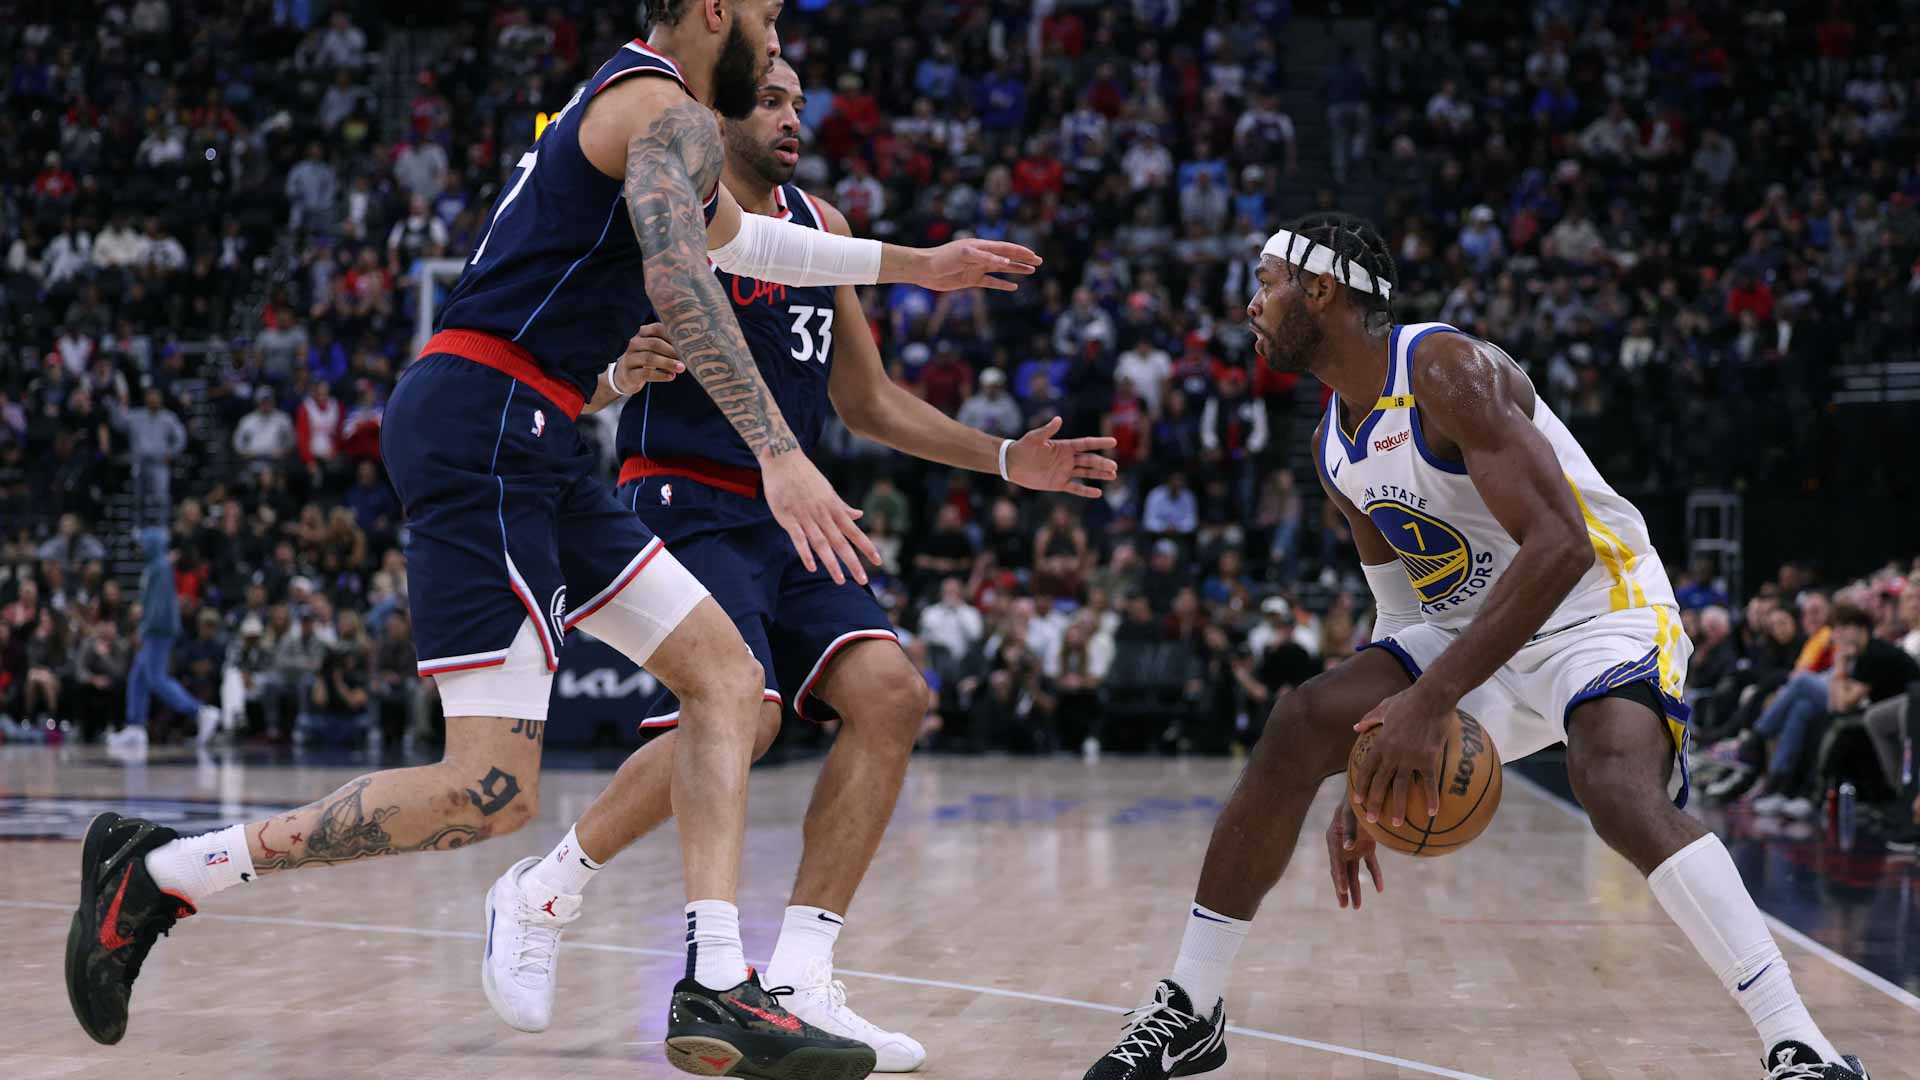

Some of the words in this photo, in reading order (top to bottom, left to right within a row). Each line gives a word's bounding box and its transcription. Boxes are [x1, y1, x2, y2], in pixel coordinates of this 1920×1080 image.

[470, 150, 539, 265] 7
[787, 305, 834, 364] 33
[1394, 397, 1405, 407] 16
[1374, 429, 1410, 452] Rakute
[1381, 485, 1428, 510] STATE
[1402, 521, 1426, 552] 7
[1421, 551, 1493, 615] ARRIORS
